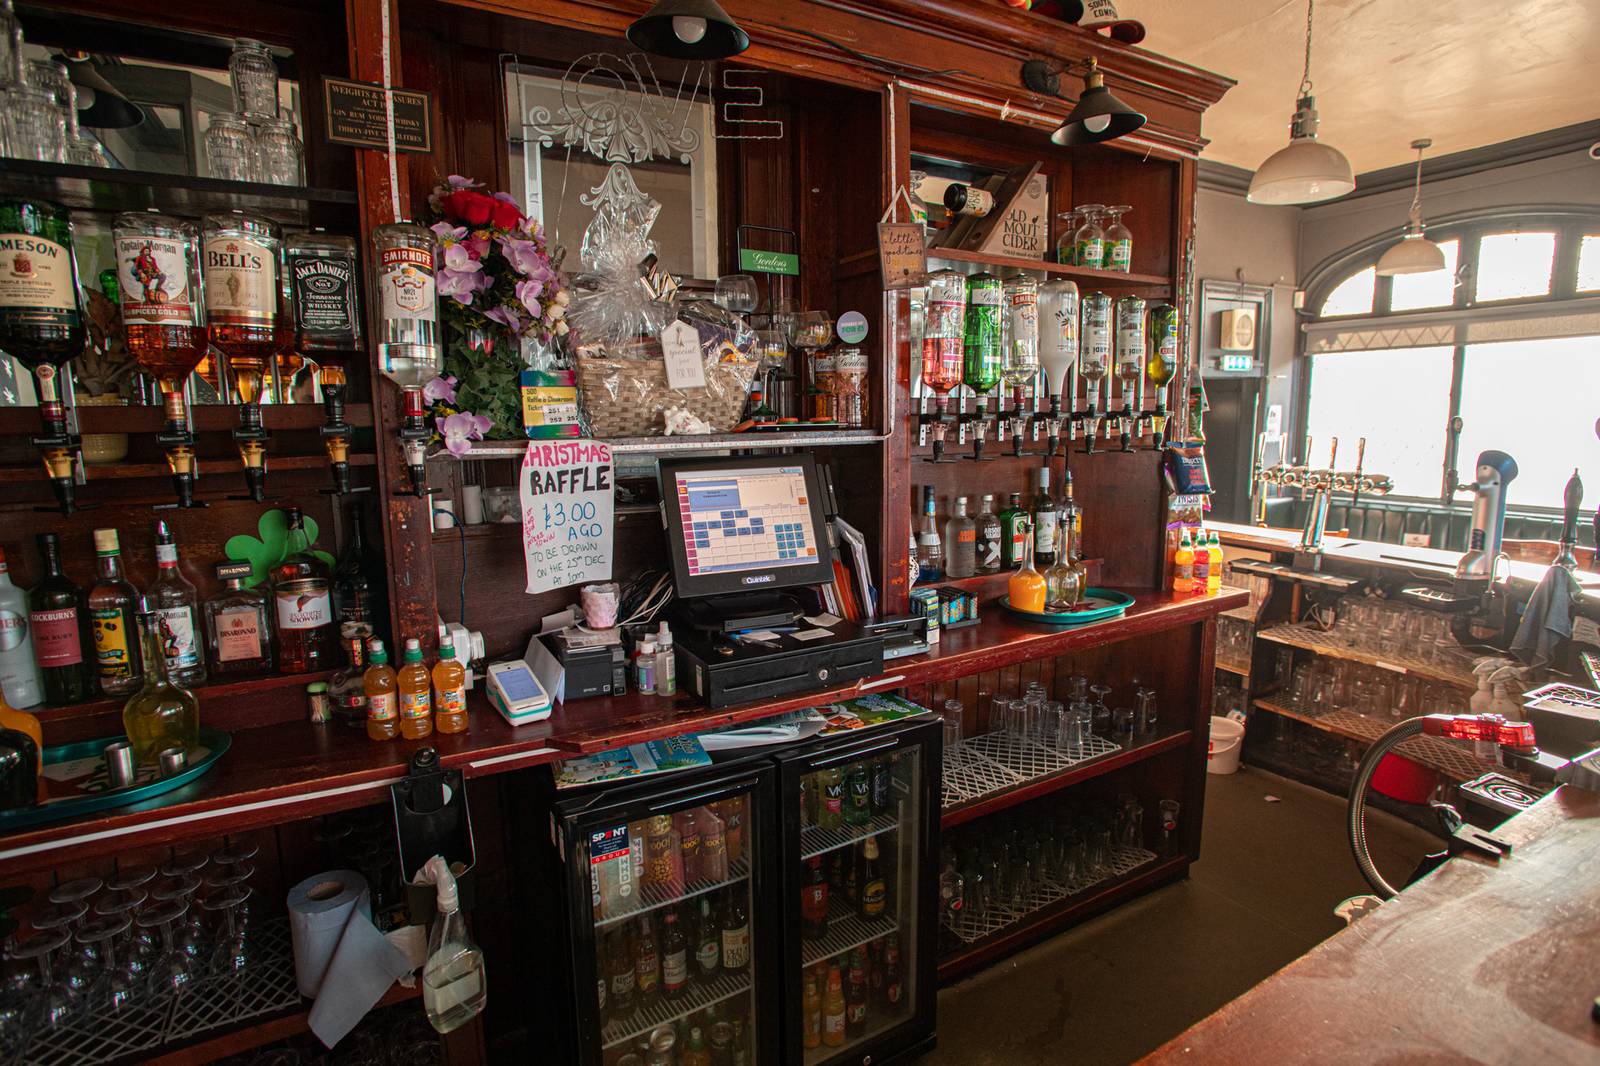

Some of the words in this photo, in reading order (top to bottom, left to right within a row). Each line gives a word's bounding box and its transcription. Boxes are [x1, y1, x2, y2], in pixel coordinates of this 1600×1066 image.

[332, 85, 370, 98] WEIGHTS
[380, 93, 423, 105] MASURES
[361, 99, 377, 107] ACT
[333, 109, 346, 117] GIN
[349, 111, 366, 119] RUM
[368, 113, 387, 122] VODK
[1004, 220, 1040, 238] MOUT
[0, 239, 58, 258] MESON
[120, 240, 144, 253] Captain
[146, 240, 177, 255] Morgan
[1002, 233, 1038, 251] CIDER
[208, 251, 262, 270] BELL'S
[384, 250, 432, 265] SMIRNOFF
[295, 263, 316, 280] JACK
[316, 261, 351, 282] DANIEL'S
[306, 291, 342, 301] Tennessee
[524, 441, 611, 468] HRISTMAS
[530, 465, 610, 496] RAFFLE
[543, 501, 596, 530] £3.00
[568, 526, 578, 541] A
[580, 523, 603, 538] GO
[532, 551, 544, 563] TO
[546, 547, 558, 560] BE
[561, 543, 599, 556] DRAWN
[220, 566, 250, 576] DISARONNO
[536, 567, 548, 579] ON
[584, 554, 607, 565] DEC
[553, 576, 562, 586] AT
[32, 611, 75, 622] COCKBURN'S
[220, 627, 257, 638] DISARONNO
[826, 783, 842, 796] VK
